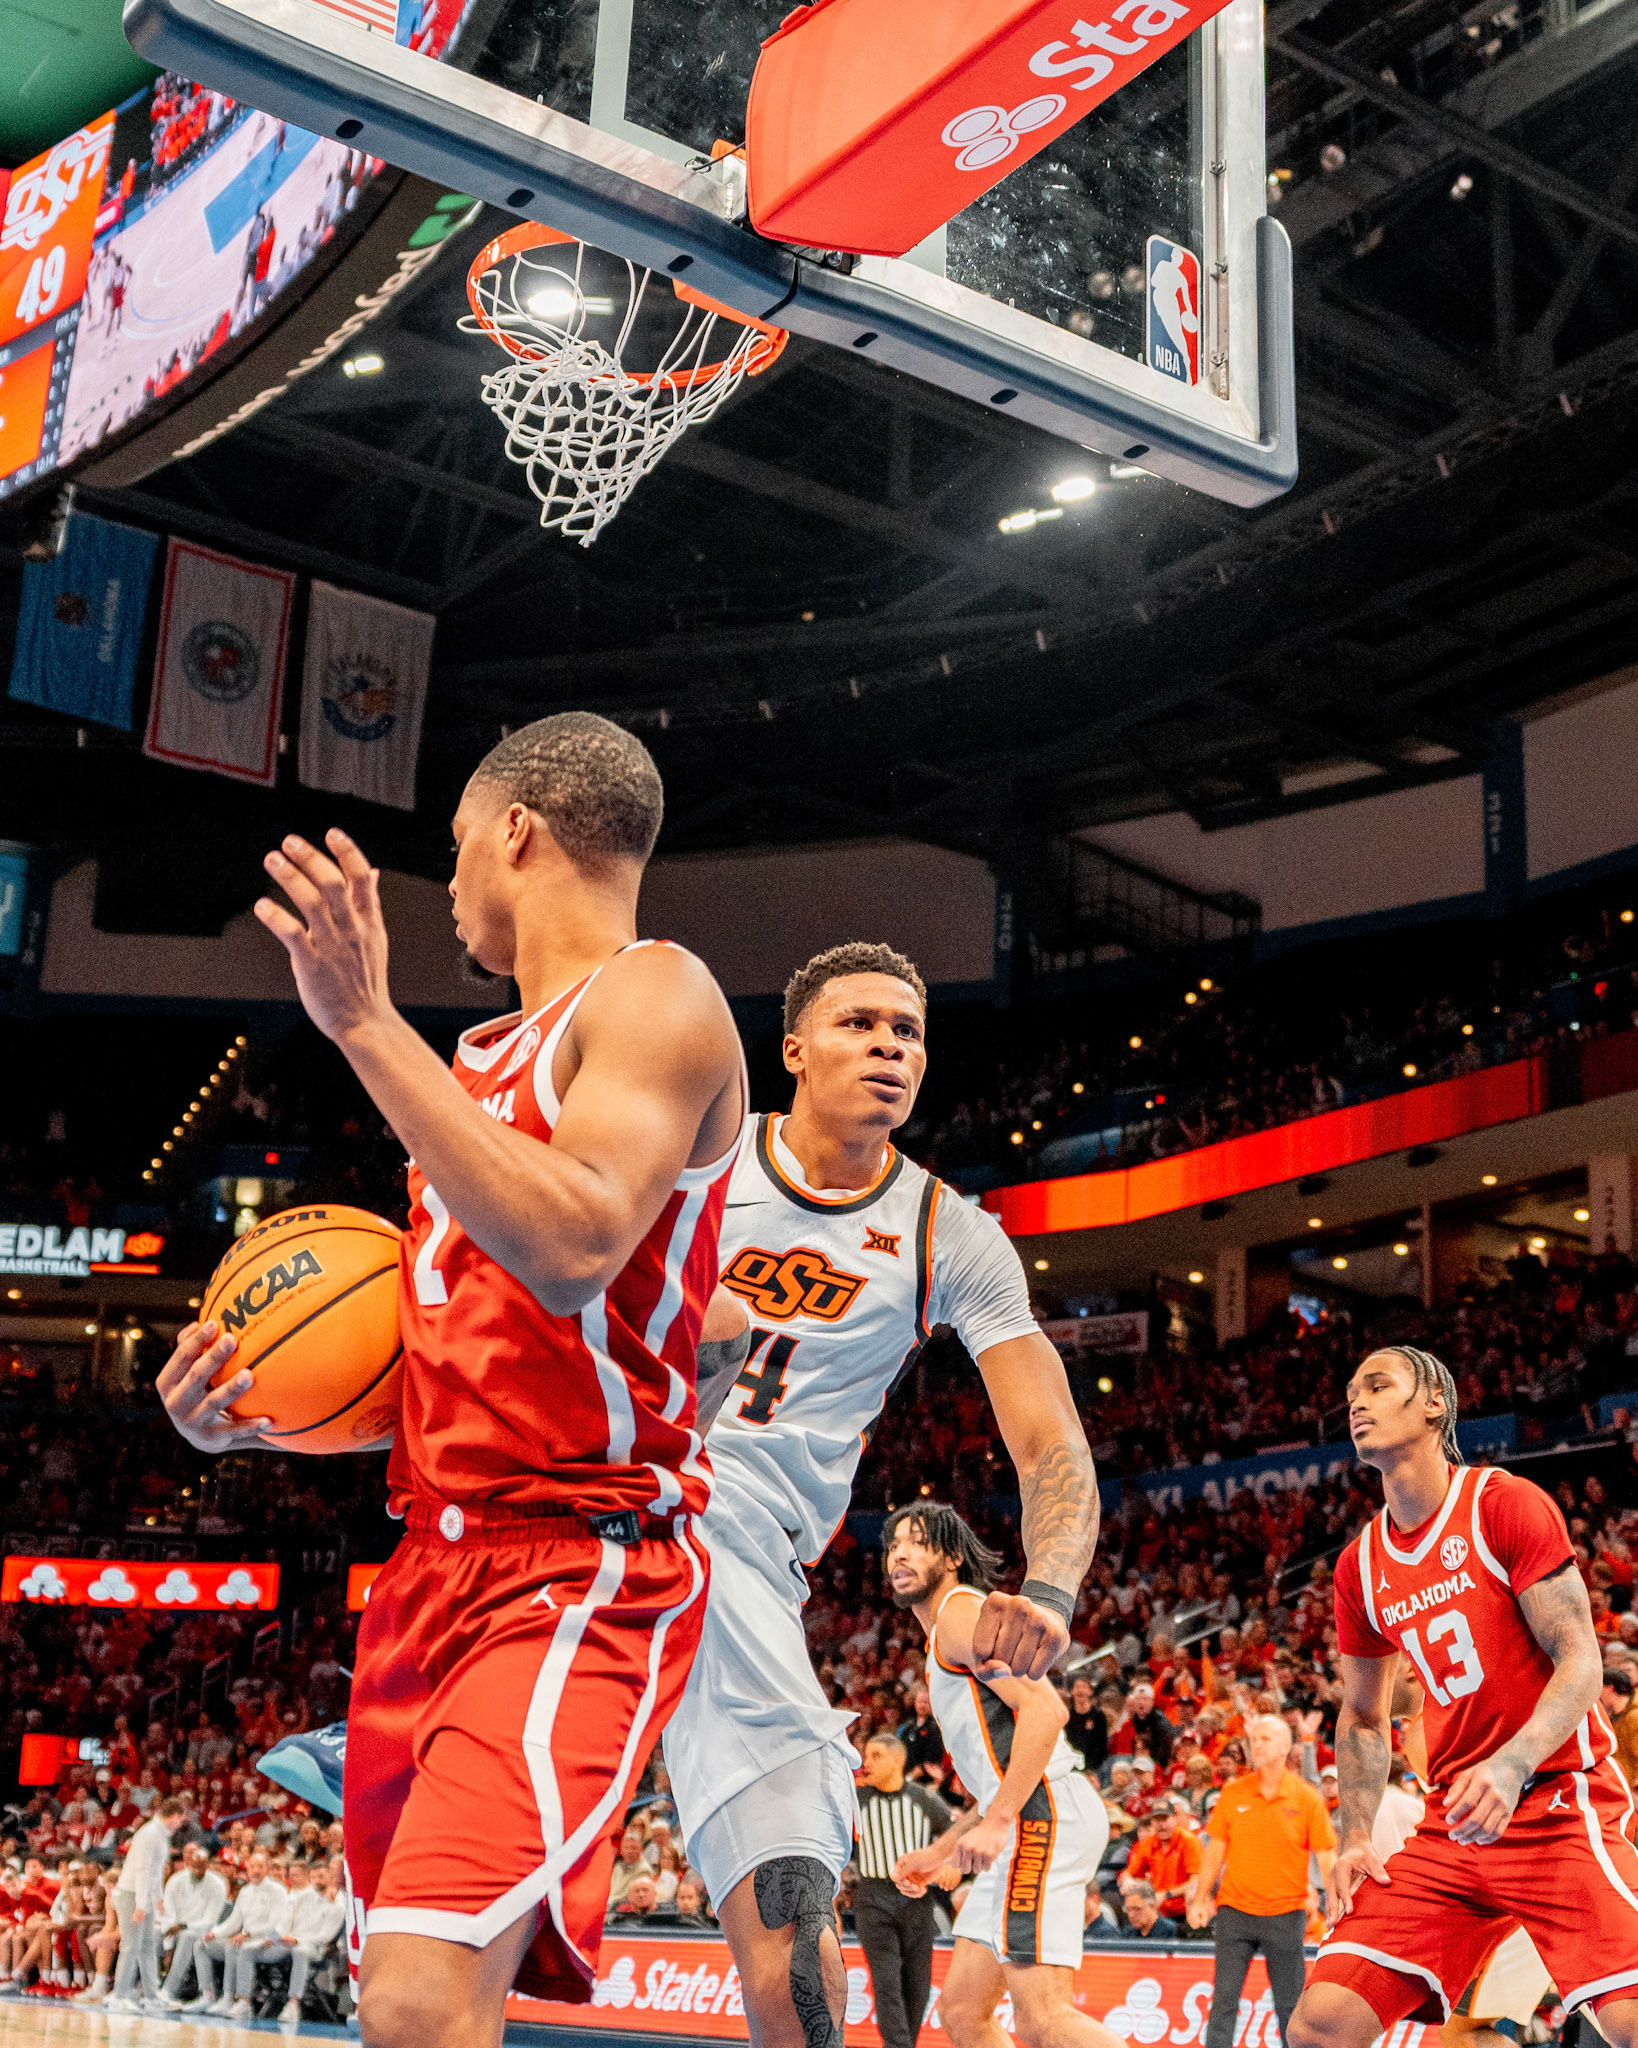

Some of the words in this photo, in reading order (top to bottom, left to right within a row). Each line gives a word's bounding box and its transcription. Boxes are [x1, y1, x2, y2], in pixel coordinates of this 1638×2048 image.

[1029, 0, 1190, 91] Sta
[15, 245, 66, 323] 49
[1155, 344, 1181, 376] NBA
[221, 1249, 324, 1332] NCAA
[718, 1246, 869, 1323] OSU
[734, 1326, 800, 1425] 4
[605, 1521, 625, 1537] 44
[1442, 1537, 1467, 1567] SEC
[1381, 1571, 1477, 1628] OKLAHOMA
[1400, 1609, 1485, 1707] 13
[1010, 1820, 1049, 1912] COWBOYS
